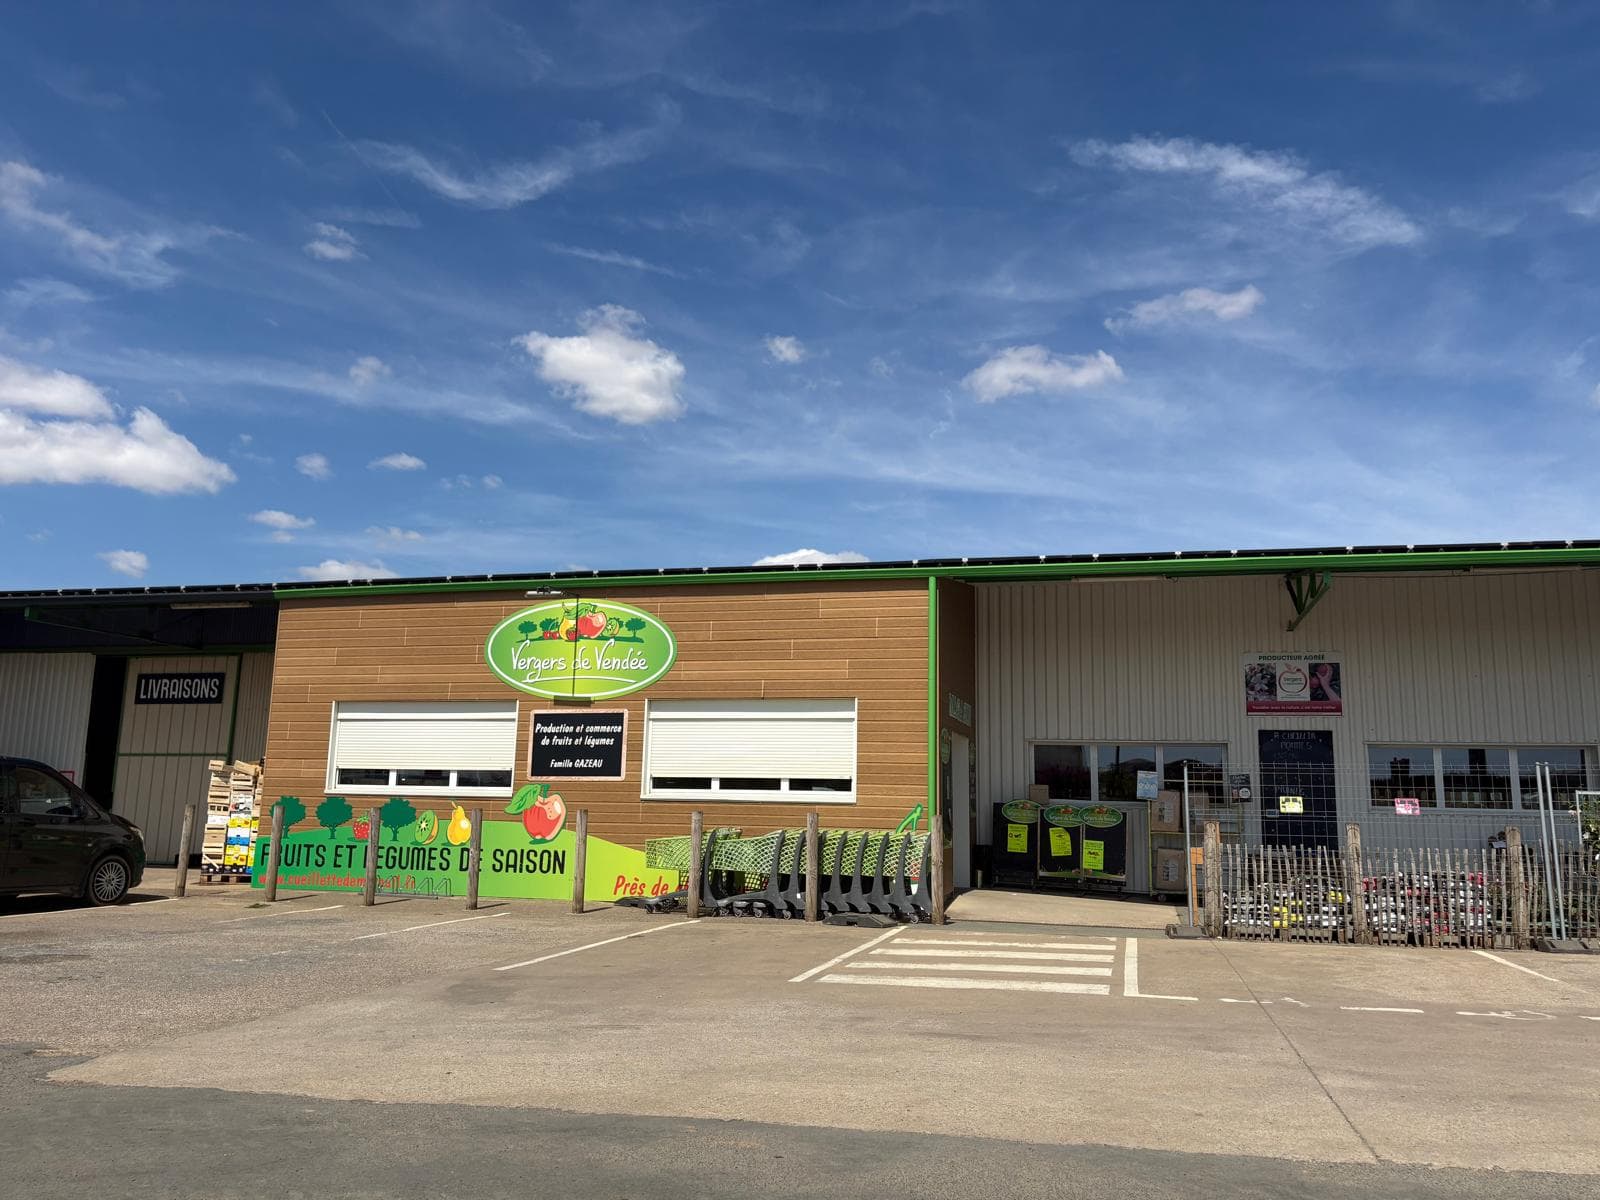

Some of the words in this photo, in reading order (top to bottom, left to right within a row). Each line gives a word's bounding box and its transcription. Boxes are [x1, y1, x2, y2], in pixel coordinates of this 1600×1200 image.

[511, 639, 567, 683] Vergers
[571, 646, 591, 670] de
[595, 638, 648, 670] Vendée
[140, 678, 219, 699] LIVRAISONS
[535, 723, 574, 733] Production
[575, 724, 584, 733] et
[585, 725, 622, 733] commerce
[541, 736, 550, 746] de
[551, 735, 573, 746] fruits
[574, 736, 583, 745] et
[584, 735, 615, 748] légumes
[550, 759, 573, 768] Famille
[574, 759, 603, 769] GAZEAU
[260, 843, 326, 868] FUITS
[333, 845, 357, 868] ET
[459, 848, 484, 872] D
[492, 849, 566, 874] SAISON
[613, 875, 646, 896] Près
[651, 876, 669, 896] de
